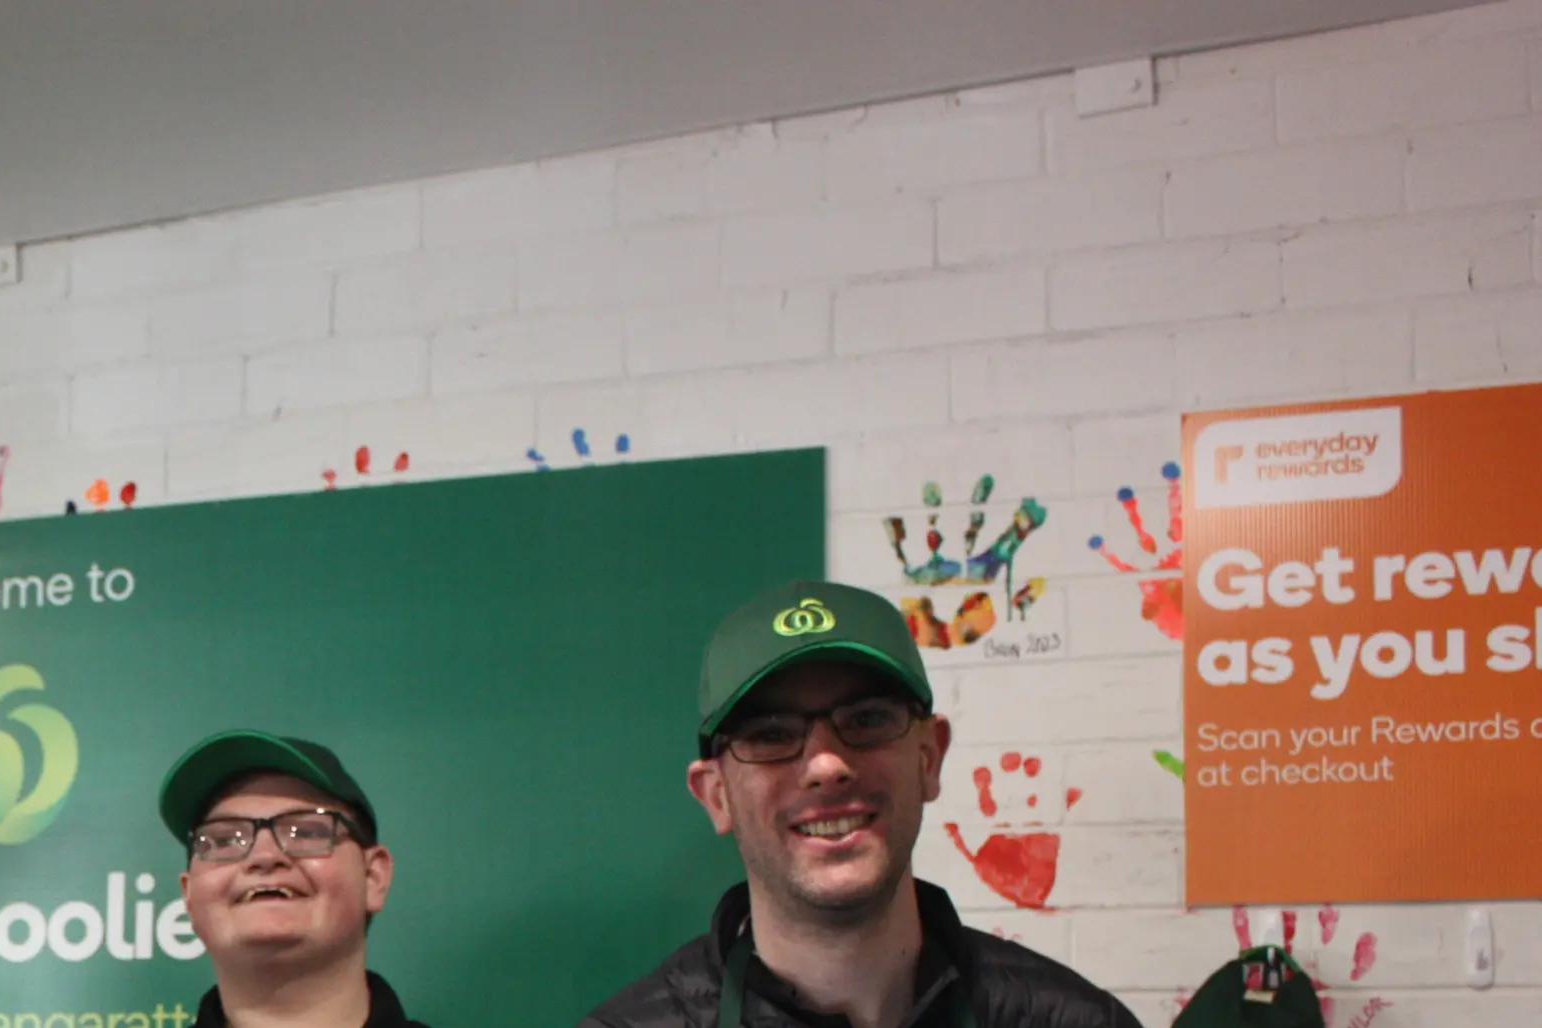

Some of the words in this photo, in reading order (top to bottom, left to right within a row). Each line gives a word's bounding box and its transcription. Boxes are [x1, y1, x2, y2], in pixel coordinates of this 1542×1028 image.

[1255, 431, 1379, 459] everyday
[1256, 454, 1365, 481] rewards
[86, 562, 135, 603] to
[1196, 546, 1356, 611] Get
[1197, 635, 1294, 687] as
[1310, 627, 1466, 701] you
[1196, 722, 1281, 752] Scan
[1288, 724, 1361, 756] your
[1370, 712, 1520, 745] Rewards
[1196, 759, 1233, 788] at
[1240, 755, 1395, 786] checkout
